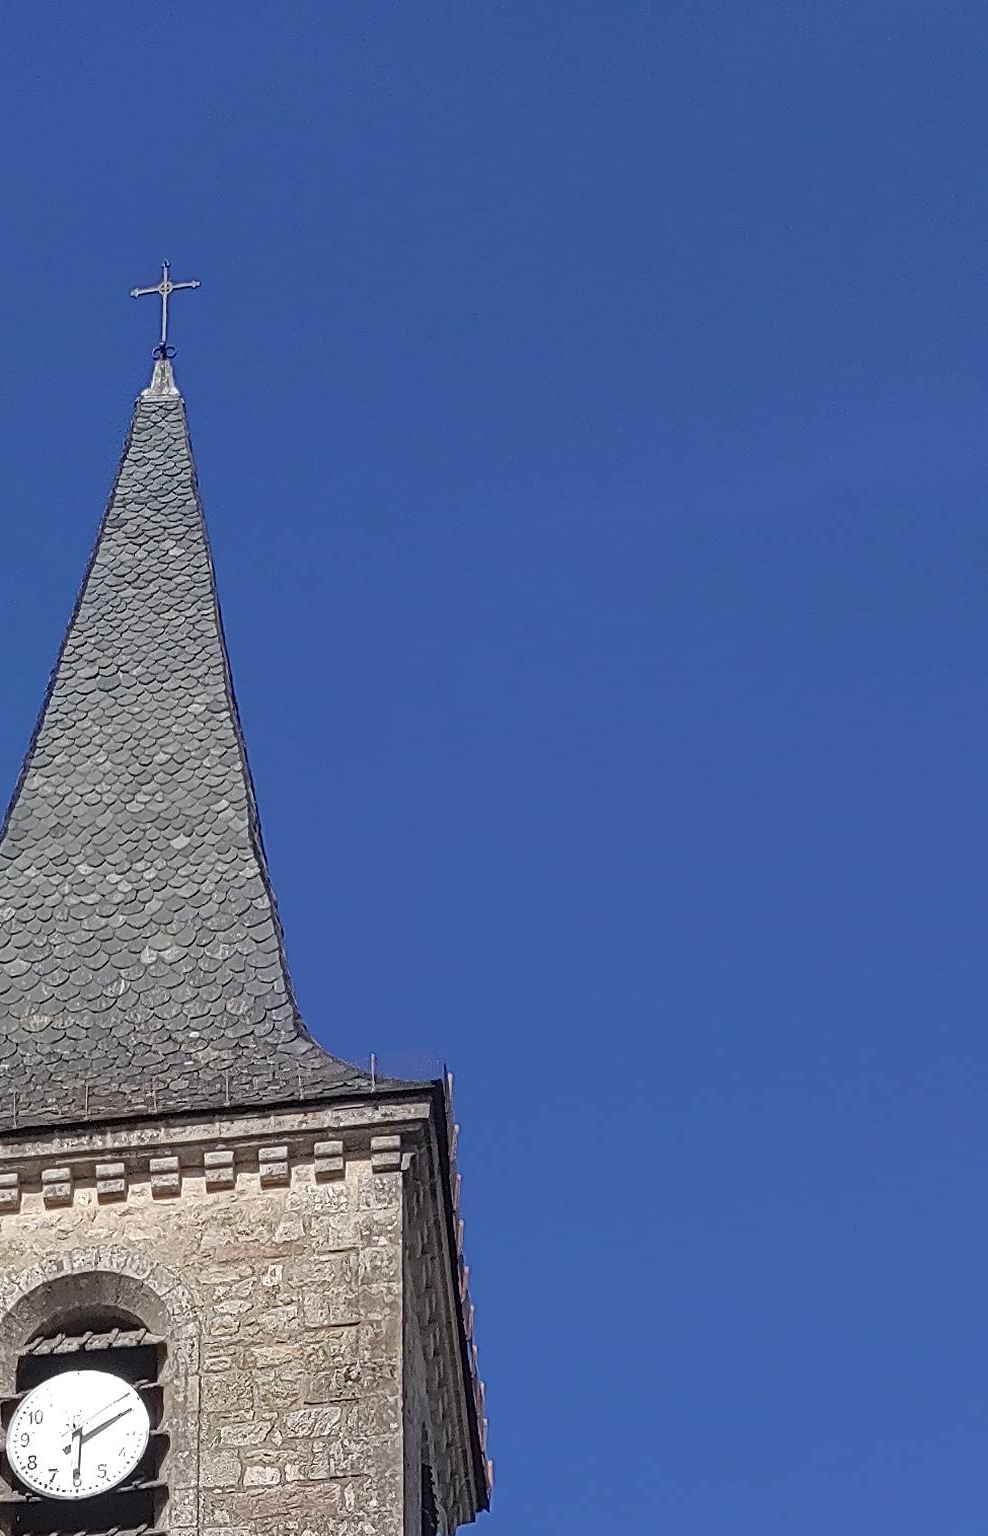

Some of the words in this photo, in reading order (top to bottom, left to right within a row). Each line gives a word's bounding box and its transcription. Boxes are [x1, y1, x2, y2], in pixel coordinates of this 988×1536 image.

[28, 1409, 44, 1425] 10
[20, 1432, 30, 1448] 9
[27, 1455, 37, 1470] 8
[48, 1468, 59, 1484] 7
[97, 1463, 107, 1479] 5
